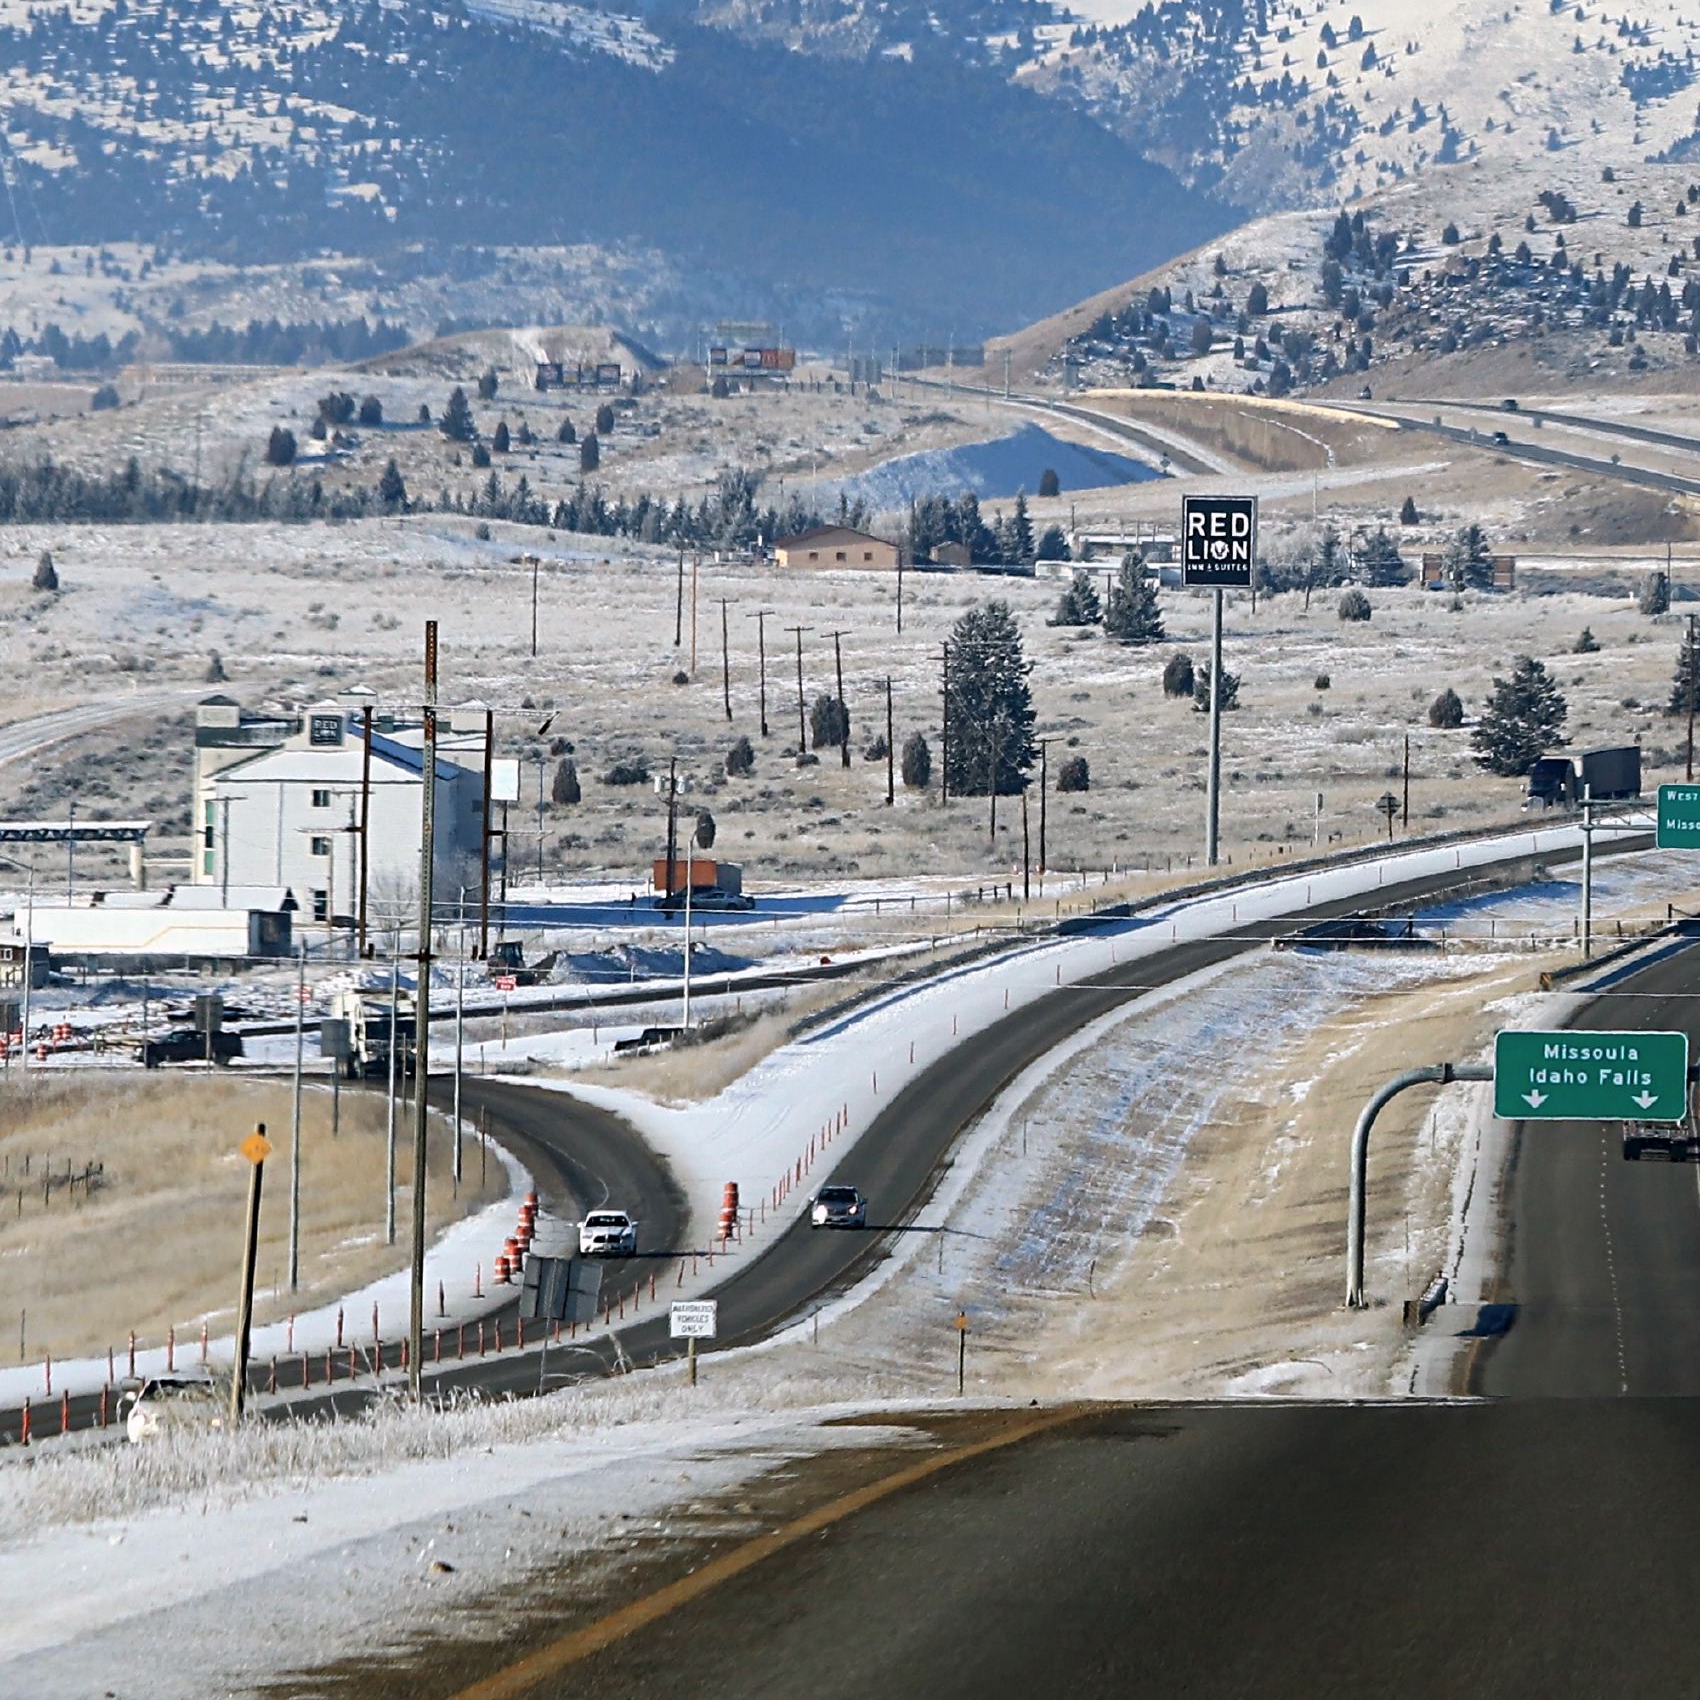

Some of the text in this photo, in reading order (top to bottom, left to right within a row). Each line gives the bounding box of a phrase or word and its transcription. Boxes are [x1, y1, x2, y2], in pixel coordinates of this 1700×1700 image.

[1188, 512, 1249, 537] RED
[1188, 540, 1248, 560] LION
[1188, 563, 1204, 571] INN
[1214, 563, 1248, 571] SUITES
[1544, 1043, 1639, 1061] Missoula
[1530, 1068, 1652, 1085] Idaho Falls
[681, 1325, 704, 1333] ONLY
